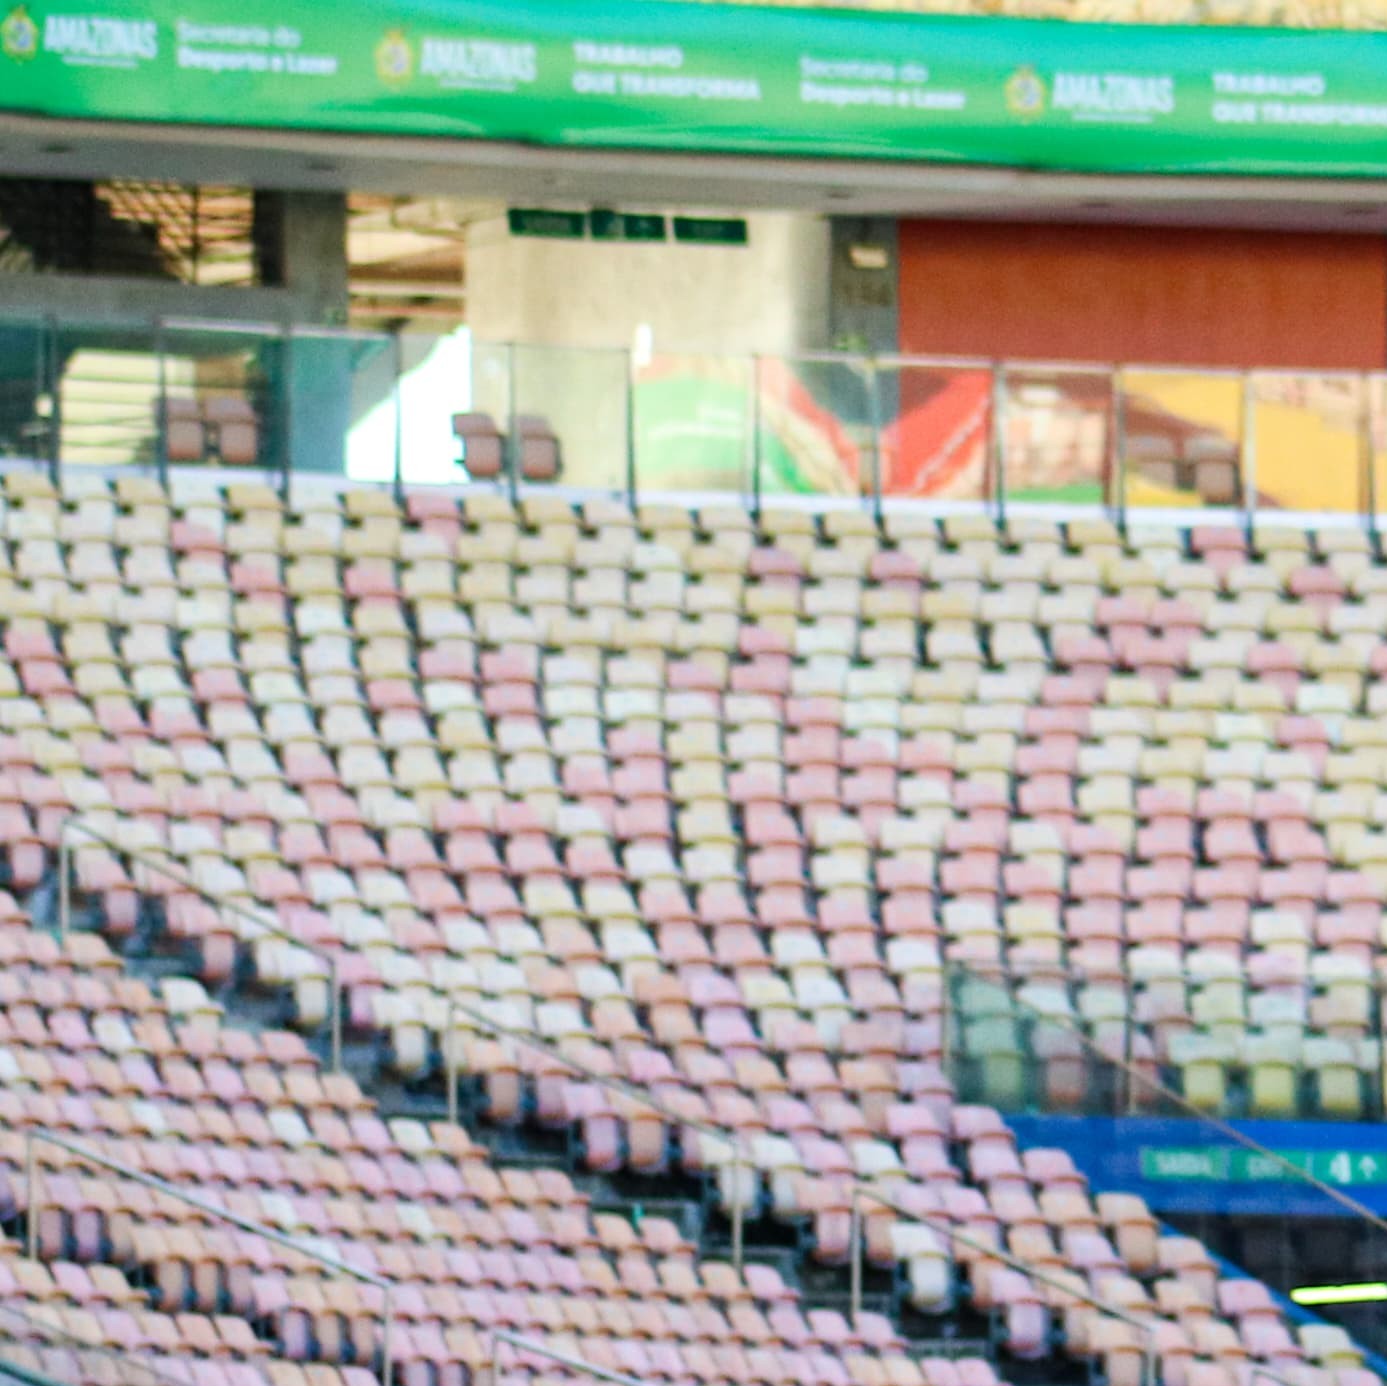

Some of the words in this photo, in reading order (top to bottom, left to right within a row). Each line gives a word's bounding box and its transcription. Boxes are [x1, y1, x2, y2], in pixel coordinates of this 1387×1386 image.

[43, 15, 158, 59] AMAZONAS
[420, 38, 536, 82] AMAZONAS
[573, 41, 683, 68] TRABALHO
[573, 71, 616, 94] QUE
[620, 75, 761, 99] TRANSFORMA
[1052, 72, 1174, 113] AMAZONAS
[1213, 72, 1325, 96] TRABALHO
[1212, 102, 1257, 123] QUE
